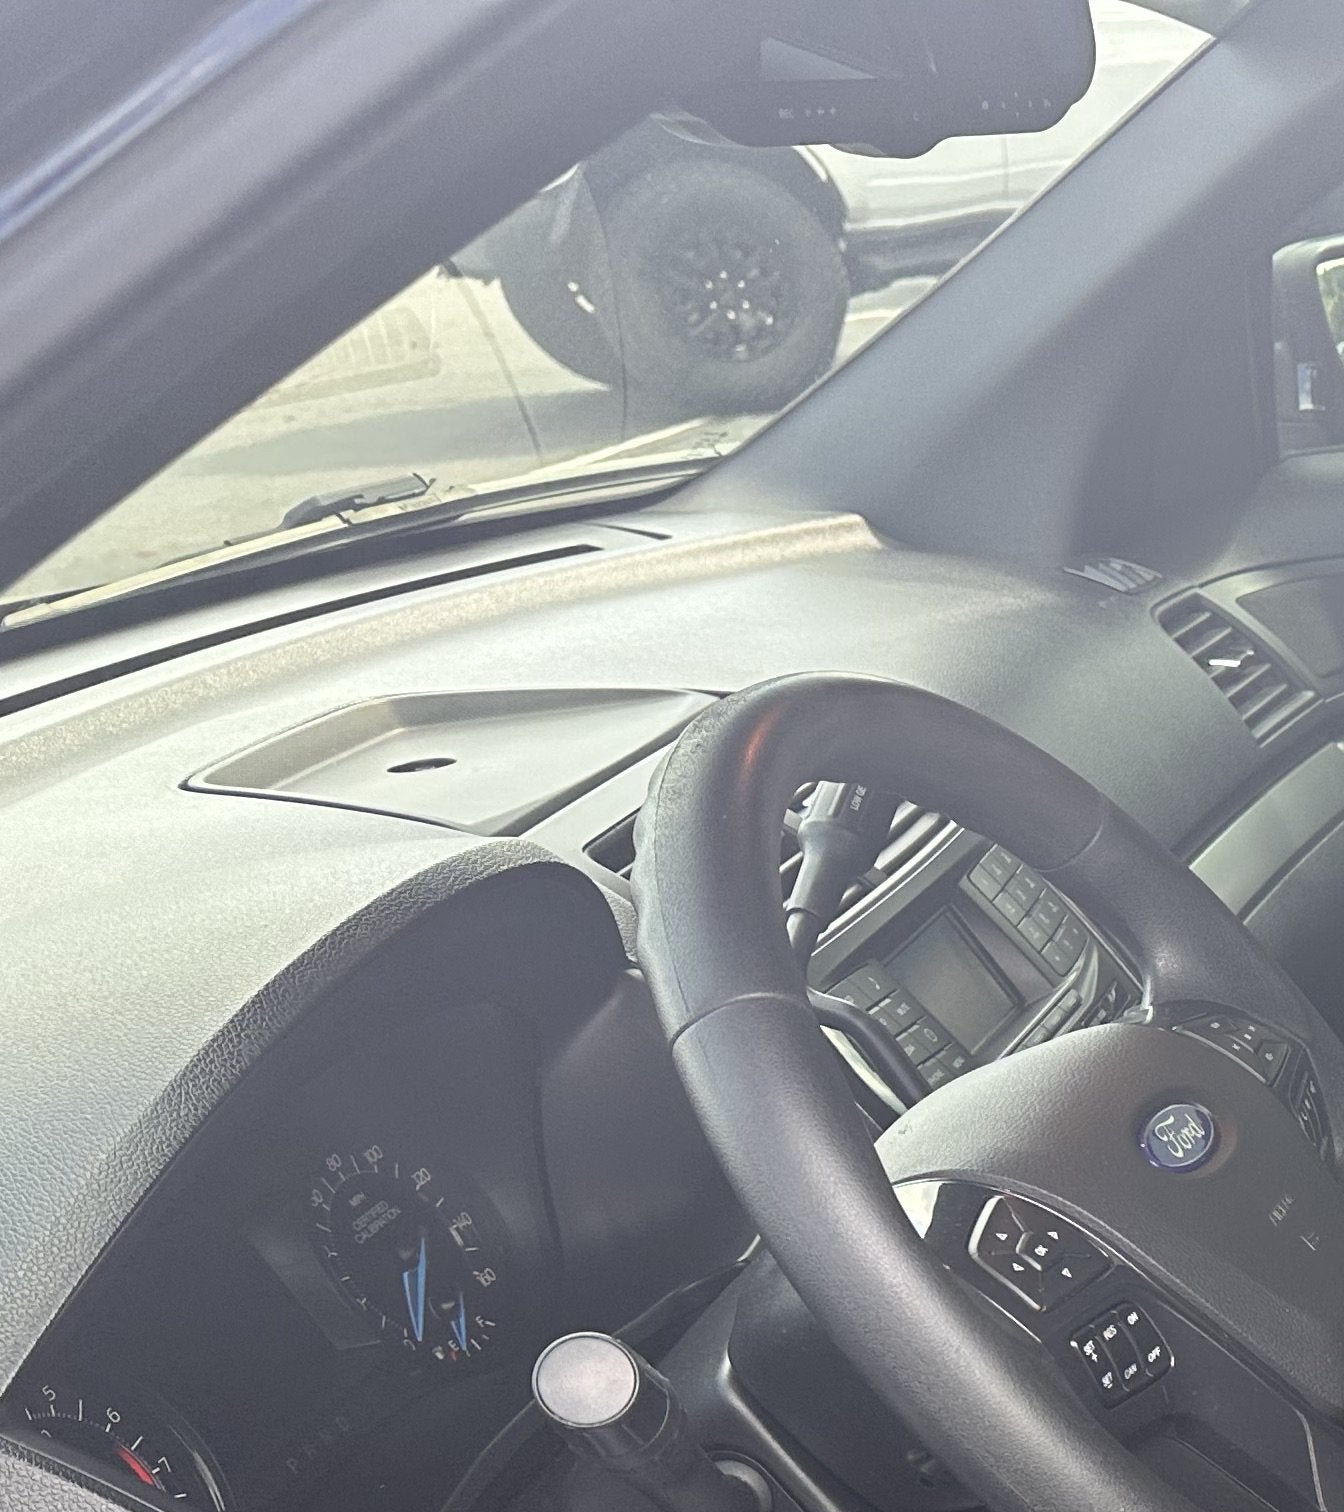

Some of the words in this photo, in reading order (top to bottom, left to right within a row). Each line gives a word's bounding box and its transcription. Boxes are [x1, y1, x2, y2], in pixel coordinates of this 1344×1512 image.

[1154, 1114, 1206, 1158] Ford
[326, 1154, 341, 1171] 80
[364, 1145, 383, 1164] 100
[1034, 1244, 1048, 1257] OK
[1127, 1312, 1139, 1325] ON
[1103, 1325, 1117, 1341] RES
[448, 1339, 460, 1352] E
[1083, 1340, 1095, 1356] SET
[1148, 1346, 1161, 1363] OFF
[1124, 1363, 1138, 1380] CAN
[42, 1385, 56, 1401] 5
[106, 1407, 121, 1424] 6
[157, 1456, 172, 1472] 7
